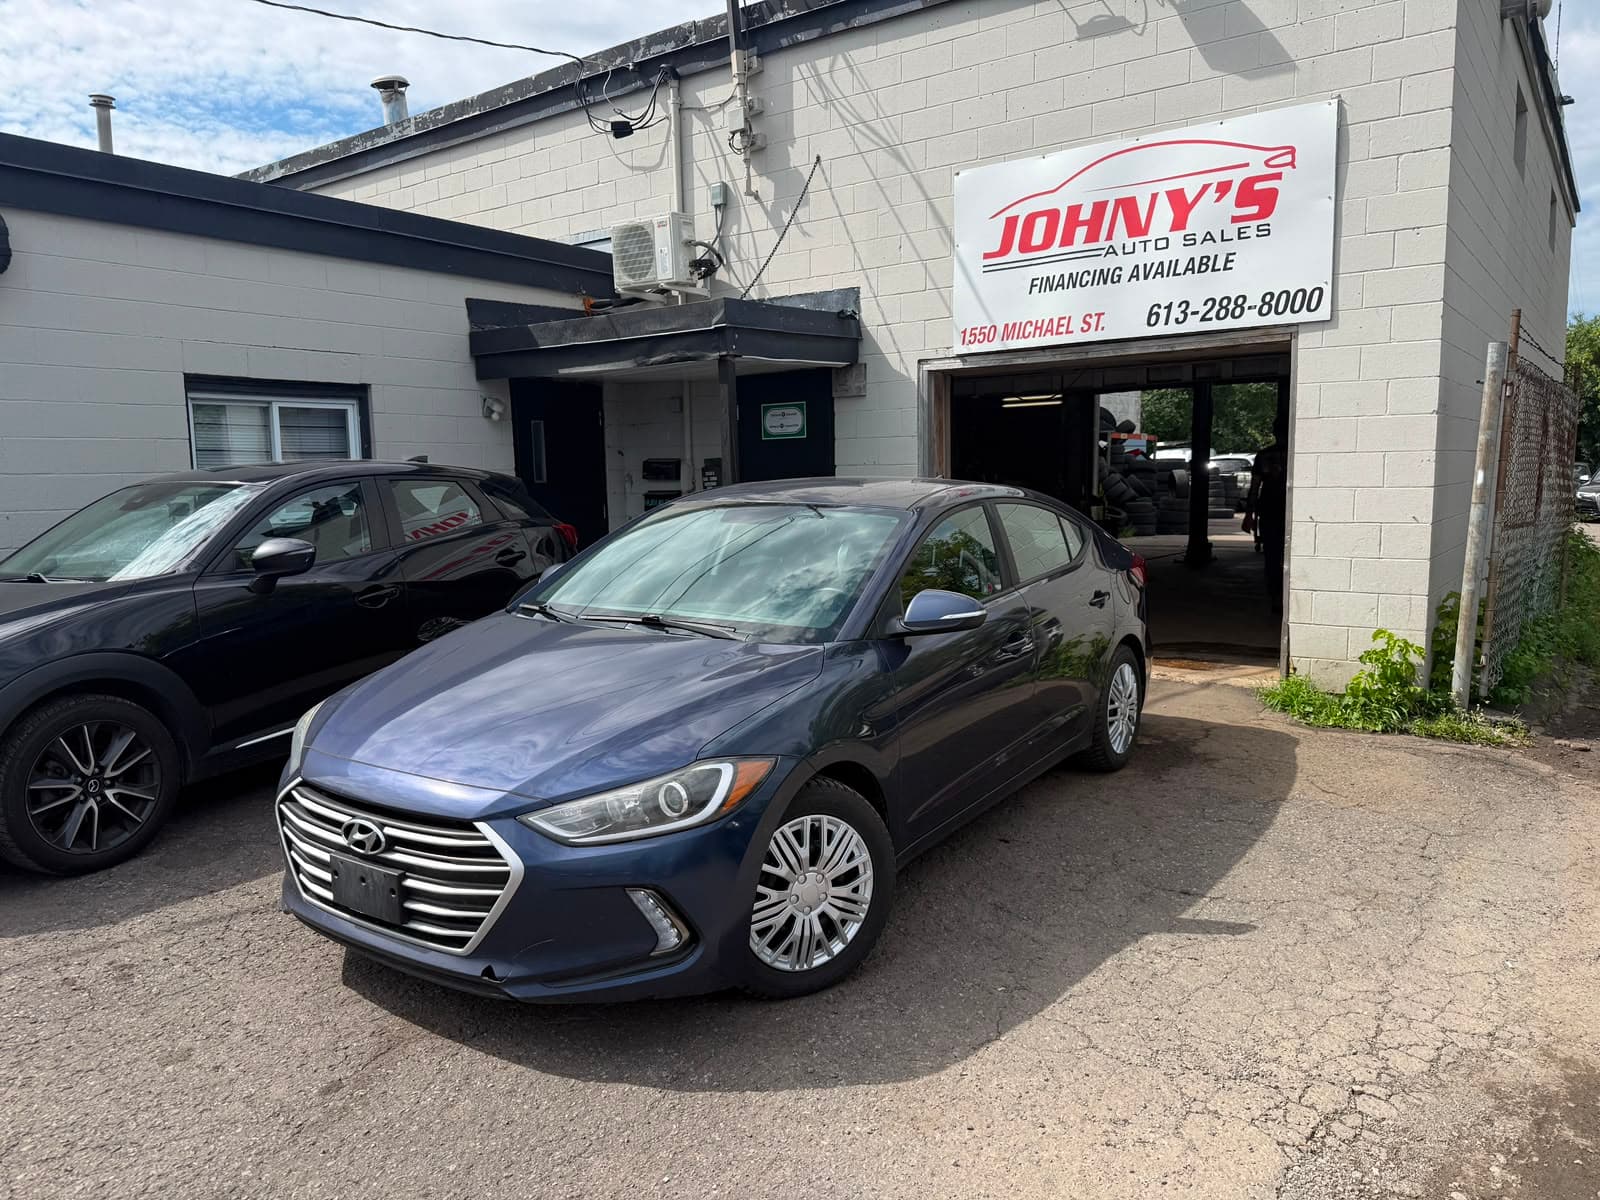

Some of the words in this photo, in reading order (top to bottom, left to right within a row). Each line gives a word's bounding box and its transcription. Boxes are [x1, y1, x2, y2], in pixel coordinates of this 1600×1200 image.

[983, 172, 1283, 260] JOHNY'S
[1103, 237, 1170, 258] AUTO
[1182, 223, 1272, 247] SALES
[1028, 266, 1123, 295] FINANCING
[1127, 252, 1237, 283] AVAILABLE
[1146, 286, 1324, 328] 613-288-8000
[960, 324, 998, 346] 1550
[1001, 315, 1074, 342] MICHAEL
[1080, 312, 1106, 333] ST.
